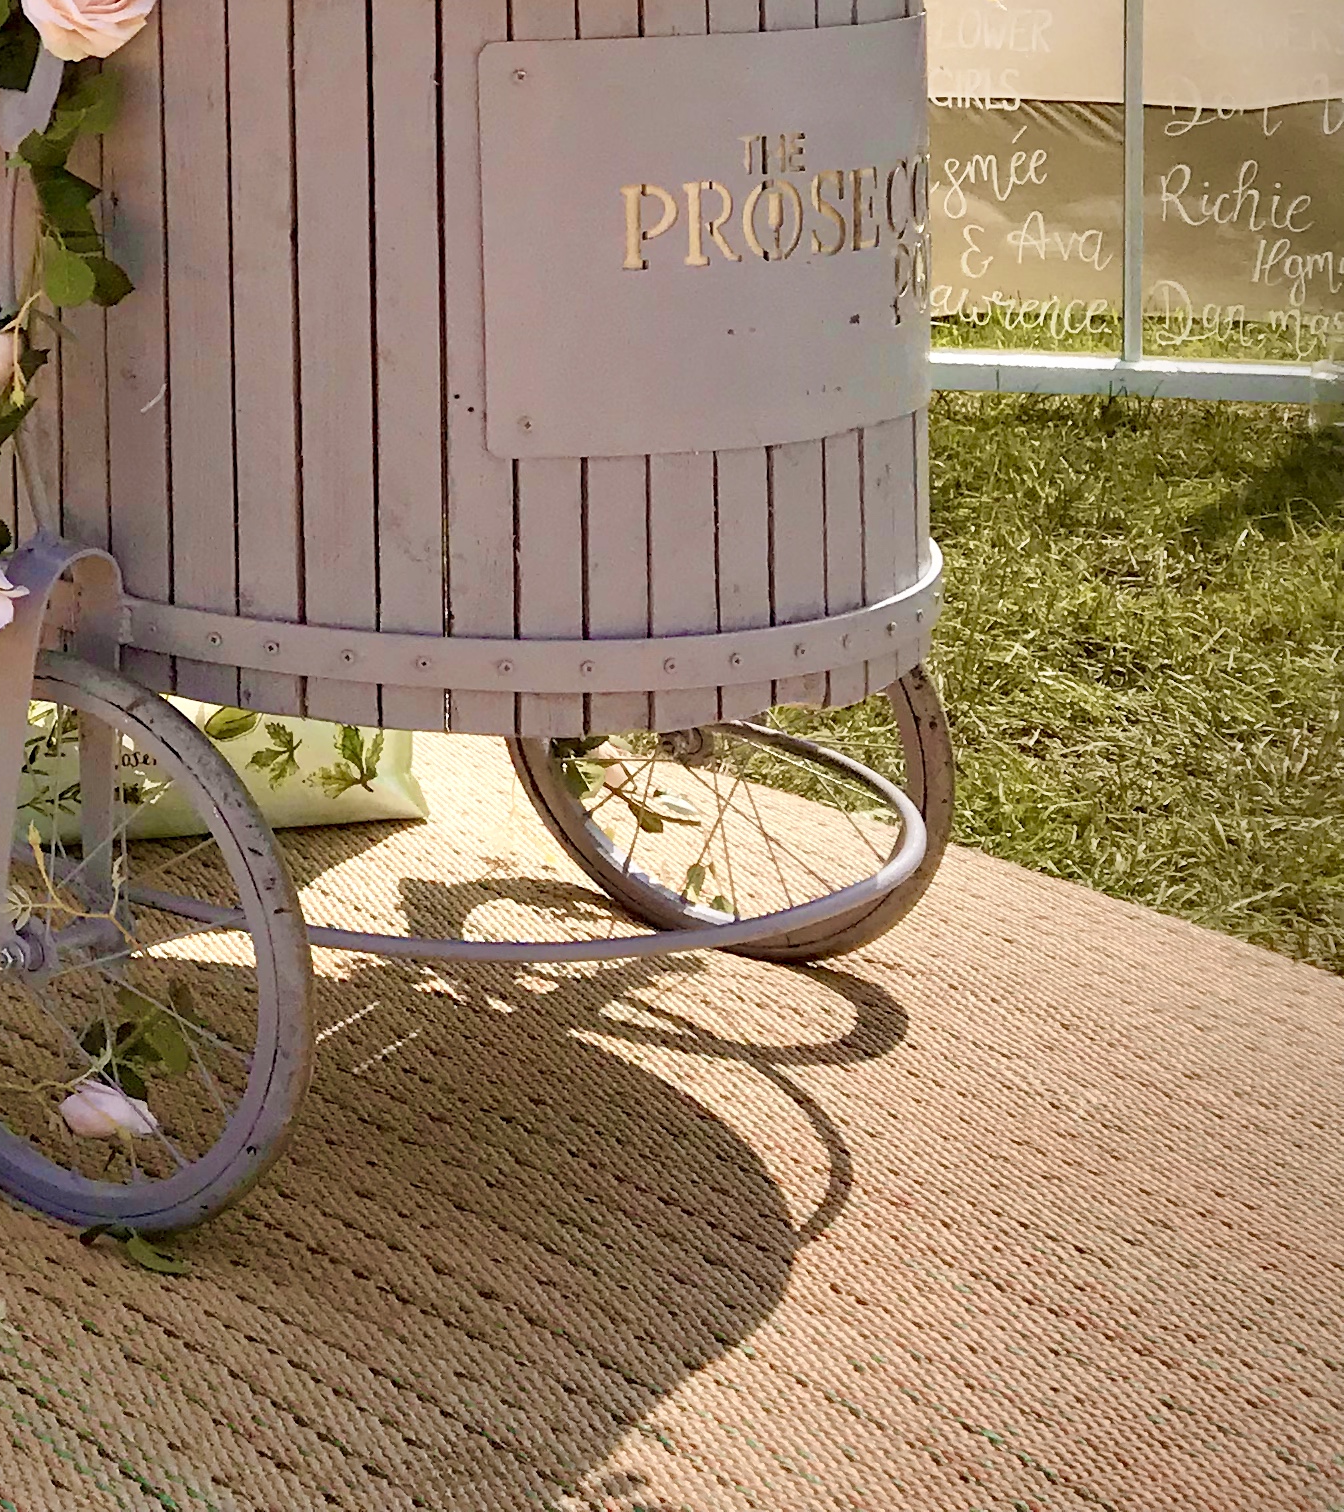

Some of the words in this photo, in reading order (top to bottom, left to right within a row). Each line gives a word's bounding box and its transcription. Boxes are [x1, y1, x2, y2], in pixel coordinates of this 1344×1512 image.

[928, 6, 1053, 53] LOWER
[928, 68, 1021, 111] GIRLS
[738, 132, 806, 175] THE
[1160, 159, 1315, 232] Richie
[1006, 210, 1113, 271] Ava
